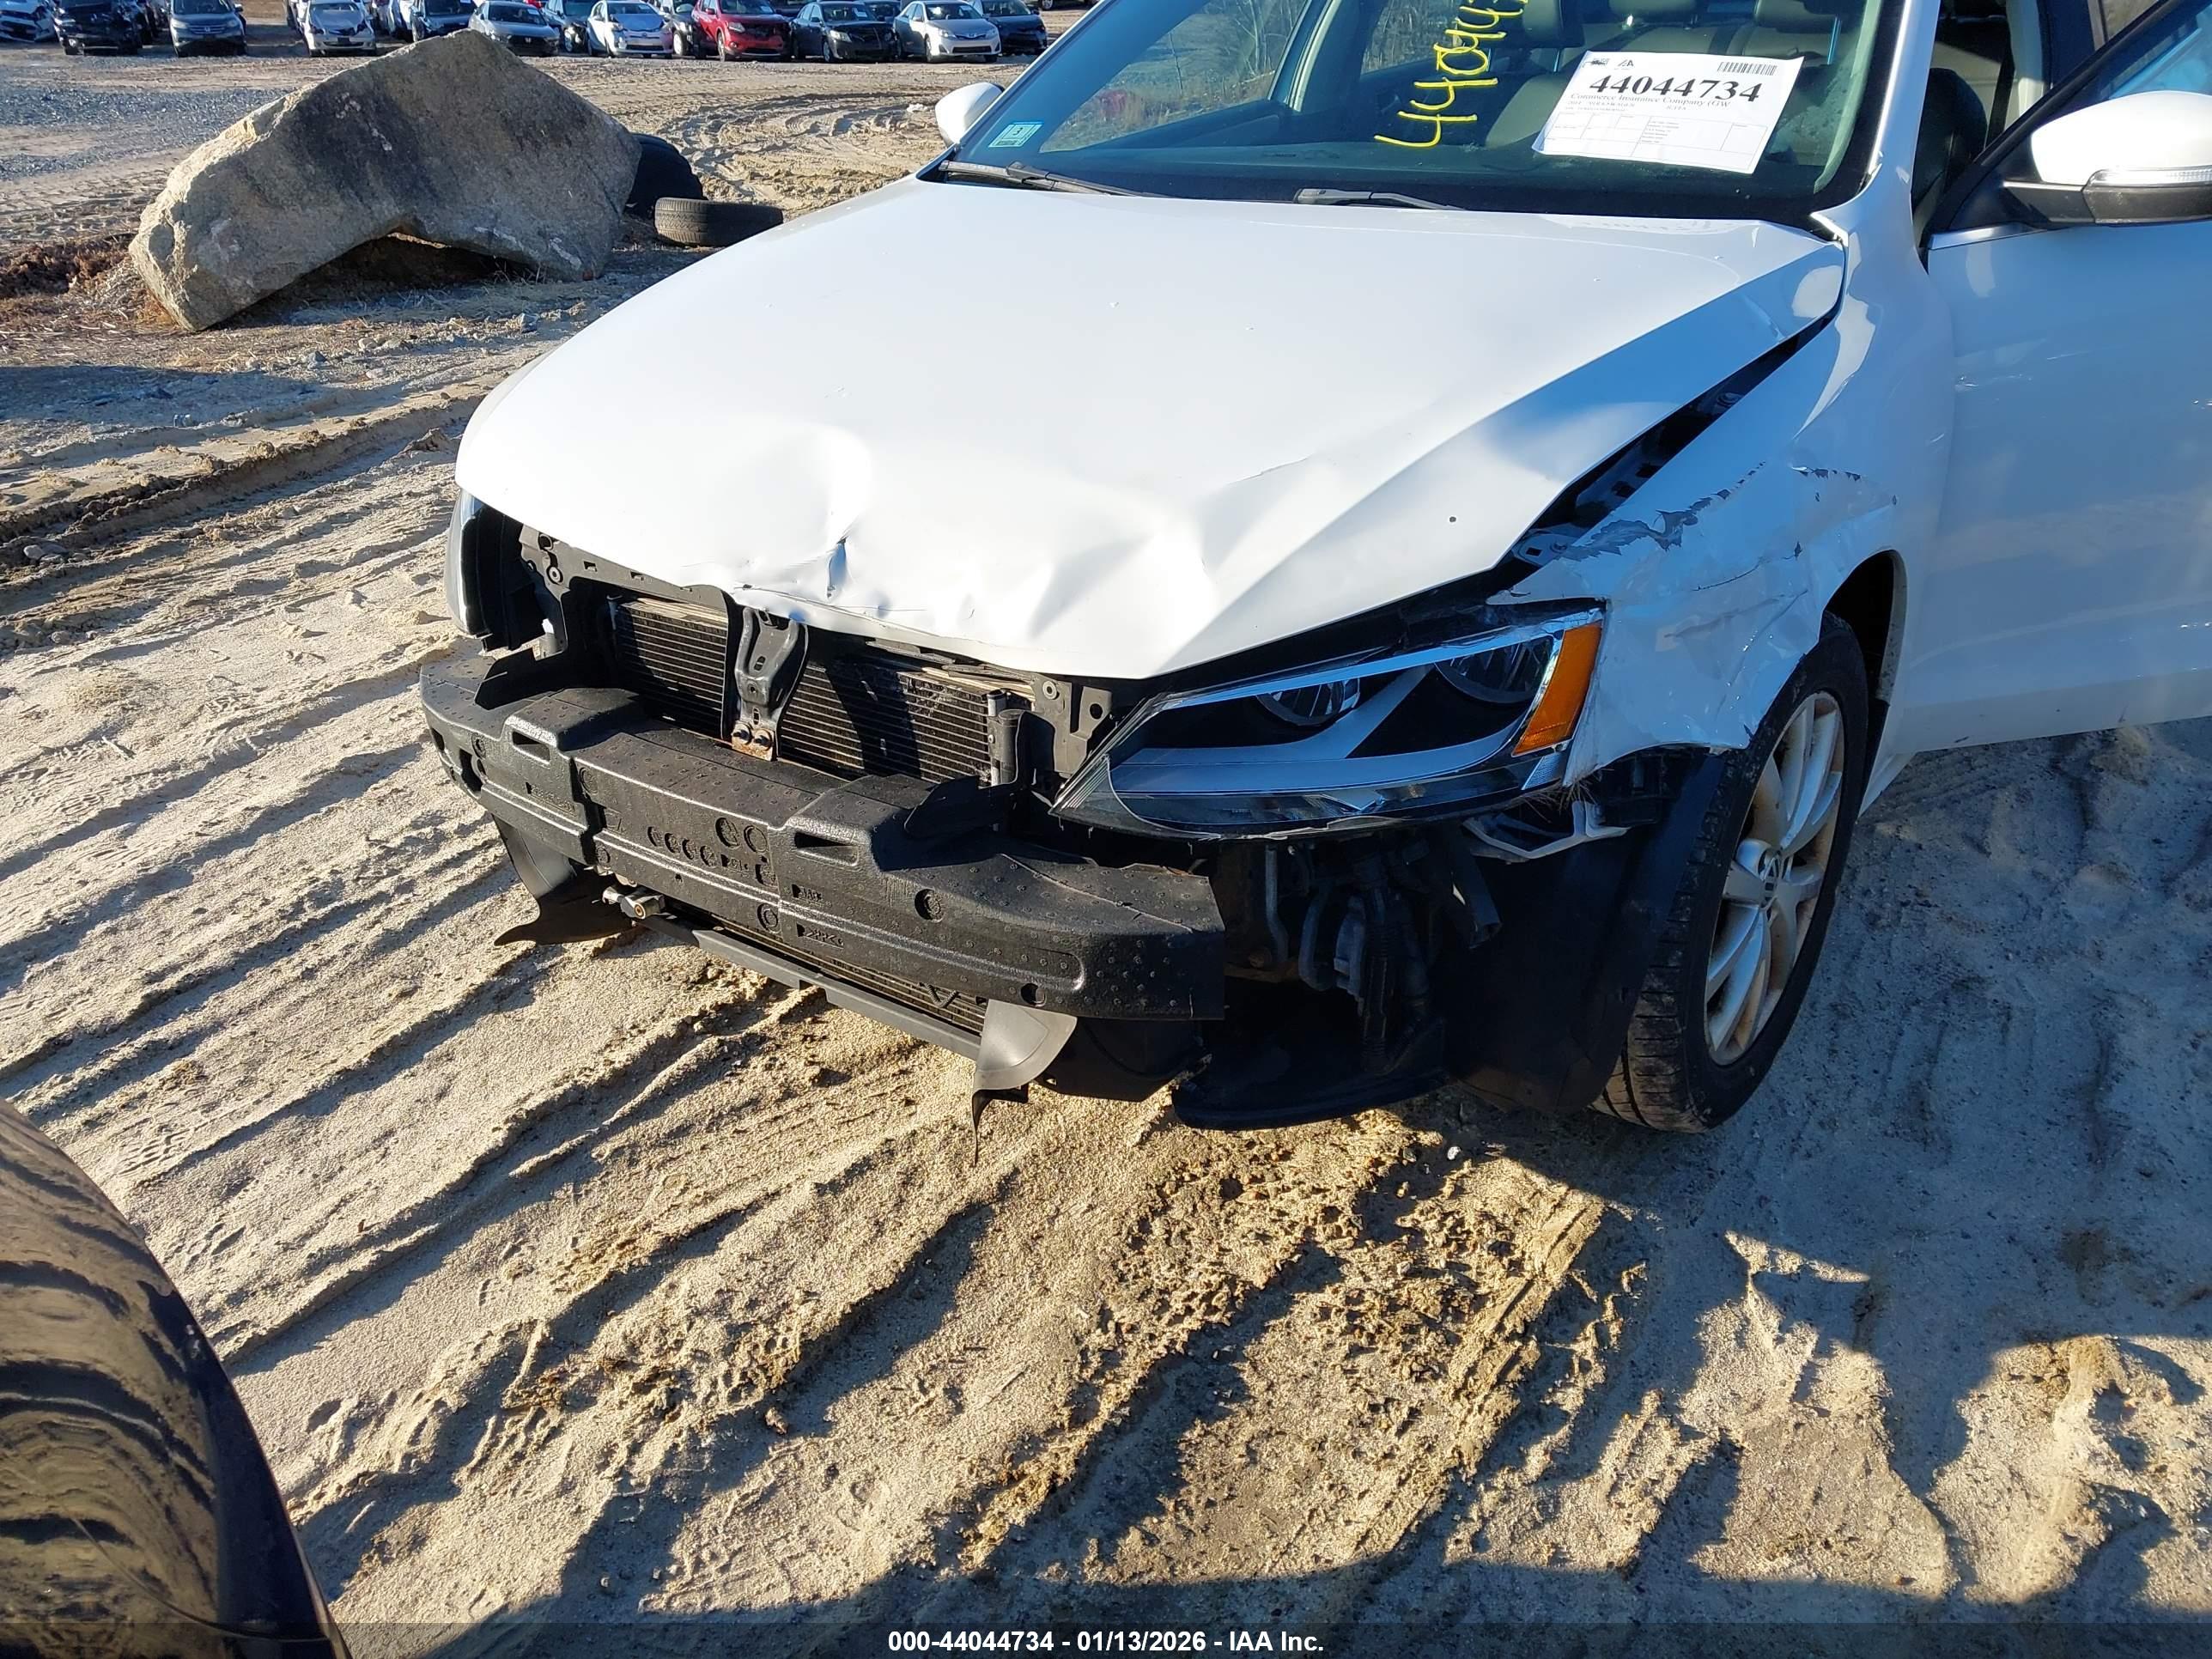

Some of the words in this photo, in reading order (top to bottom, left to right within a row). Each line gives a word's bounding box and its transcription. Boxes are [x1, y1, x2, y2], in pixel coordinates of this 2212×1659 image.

[1374, 0, 1528, 147] 44044
[1589, 75, 1762, 102] 44044734
[1619, 94, 1659, 103] Insurance
[1662, 97, 1705, 107] Company
